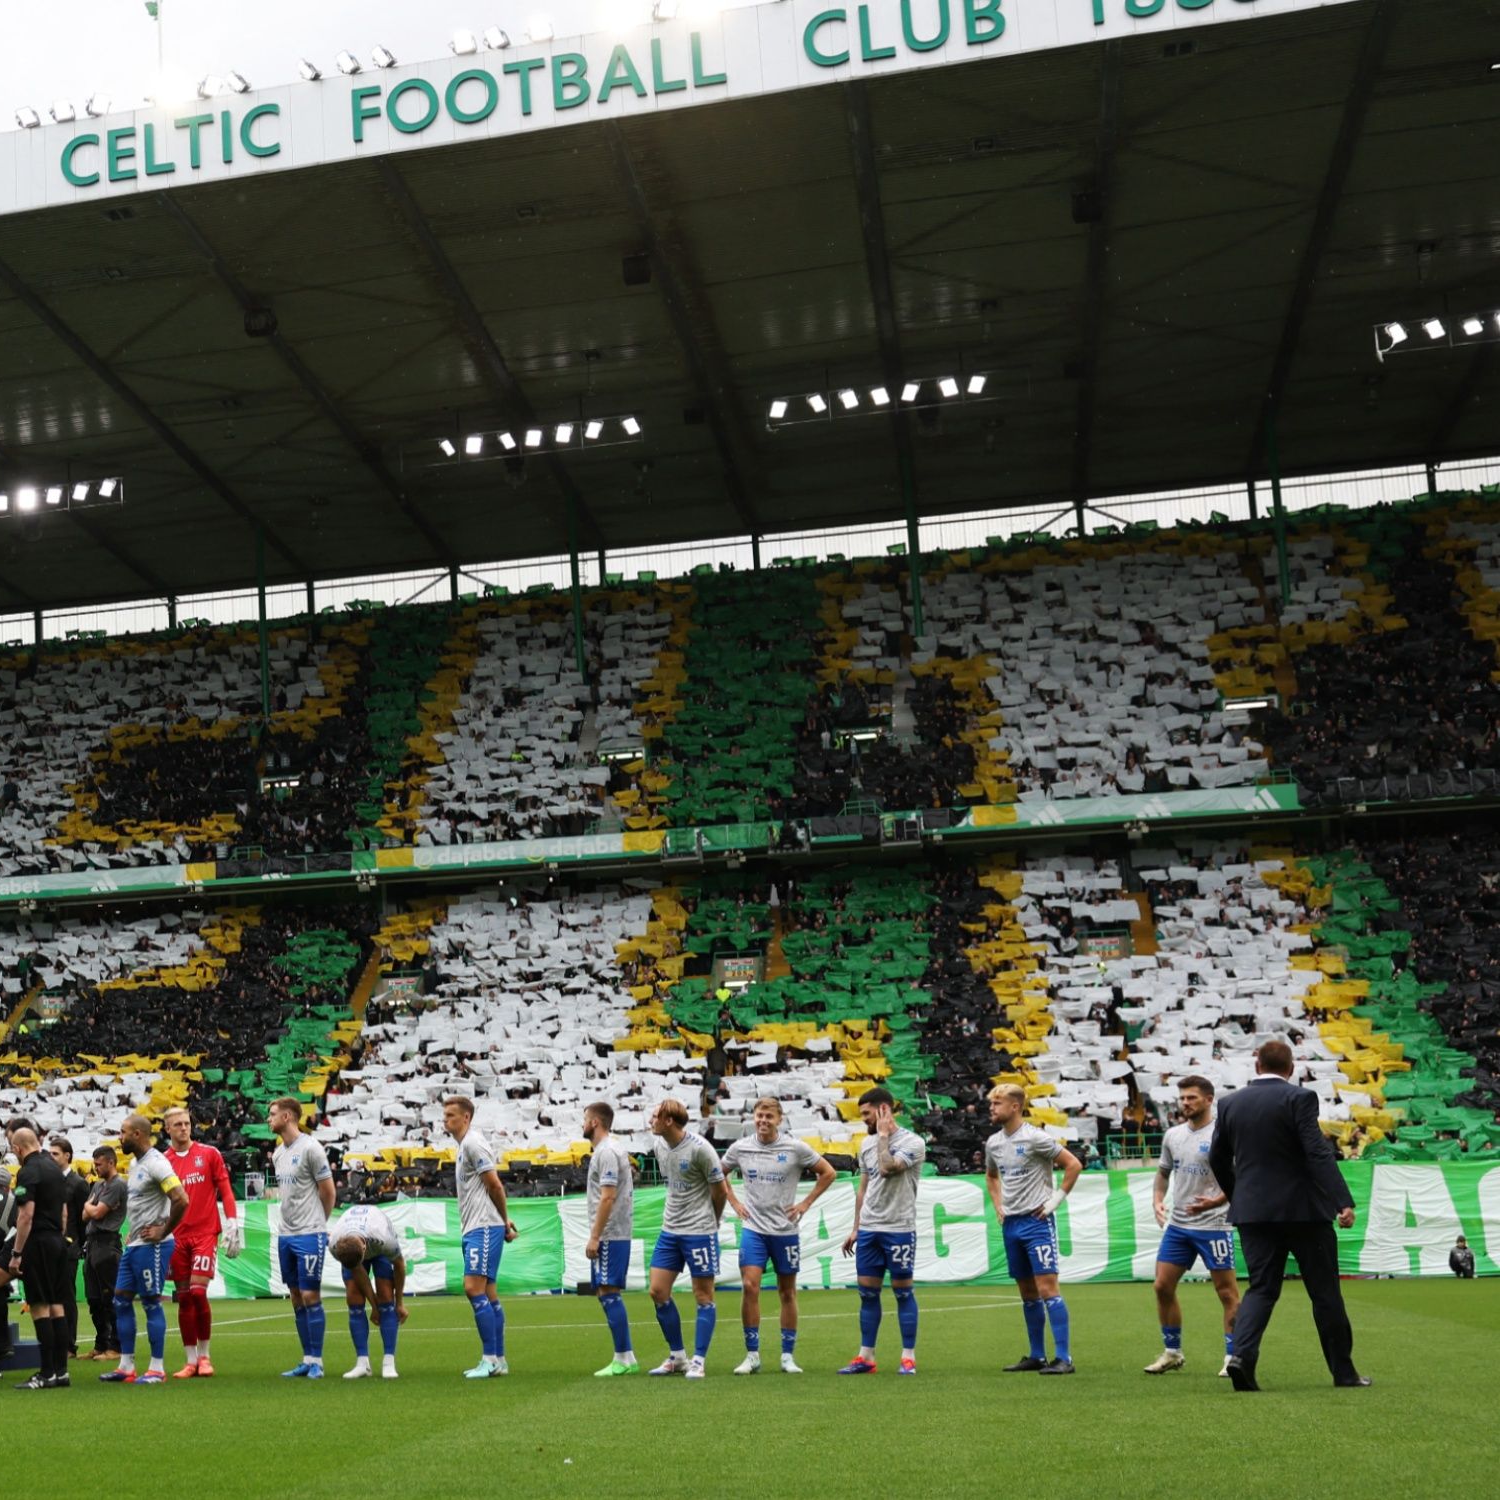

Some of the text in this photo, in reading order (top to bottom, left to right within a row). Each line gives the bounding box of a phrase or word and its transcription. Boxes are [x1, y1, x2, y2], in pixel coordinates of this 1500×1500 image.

[60, 0, 1006, 187] CELTIC FOOTBALL CLUB
[546, 837, 623, 859] dafabe
[469, 1248, 479, 1265] 5
[691, 1248, 709, 1264] 51
[784, 1246, 799, 1262] 15
[891, 1245, 911, 1261] 22
[1034, 1245, 1051, 1262] 12
[1209, 1239, 1227, 1258] 10
[192, 1255, 210, 1271] 20
[304, 1254, 318, 1272] 17
[142, 1269, 152, 1284] 9
